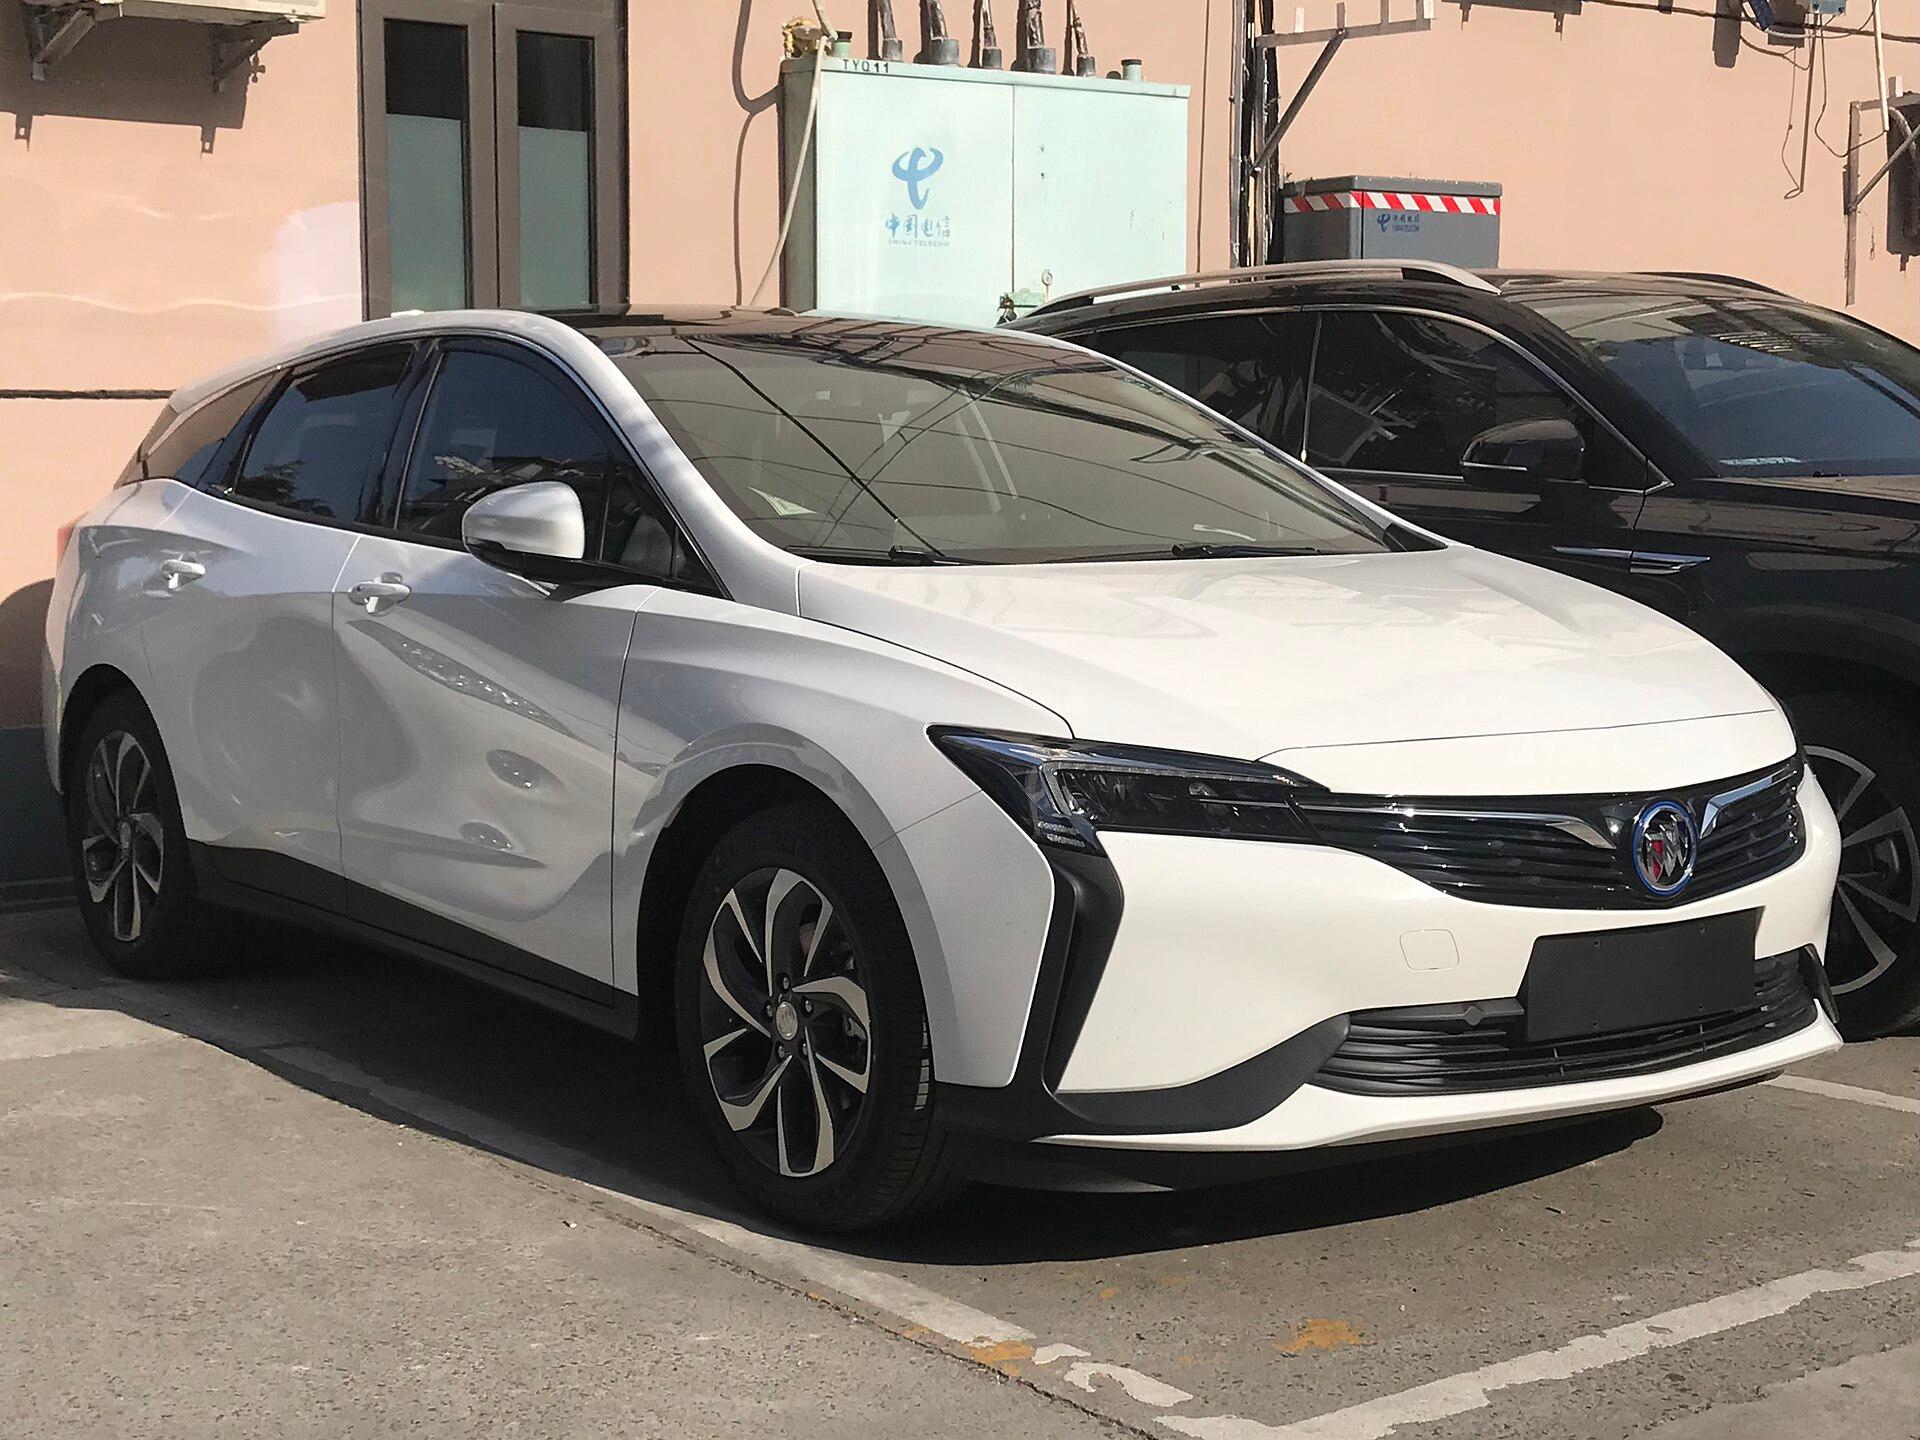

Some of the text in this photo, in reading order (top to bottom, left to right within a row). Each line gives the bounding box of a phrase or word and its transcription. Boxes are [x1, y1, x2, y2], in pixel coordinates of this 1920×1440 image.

[843, 59, 889, 73] TYQ11
[885, 213, 951, 239] 中国电信
